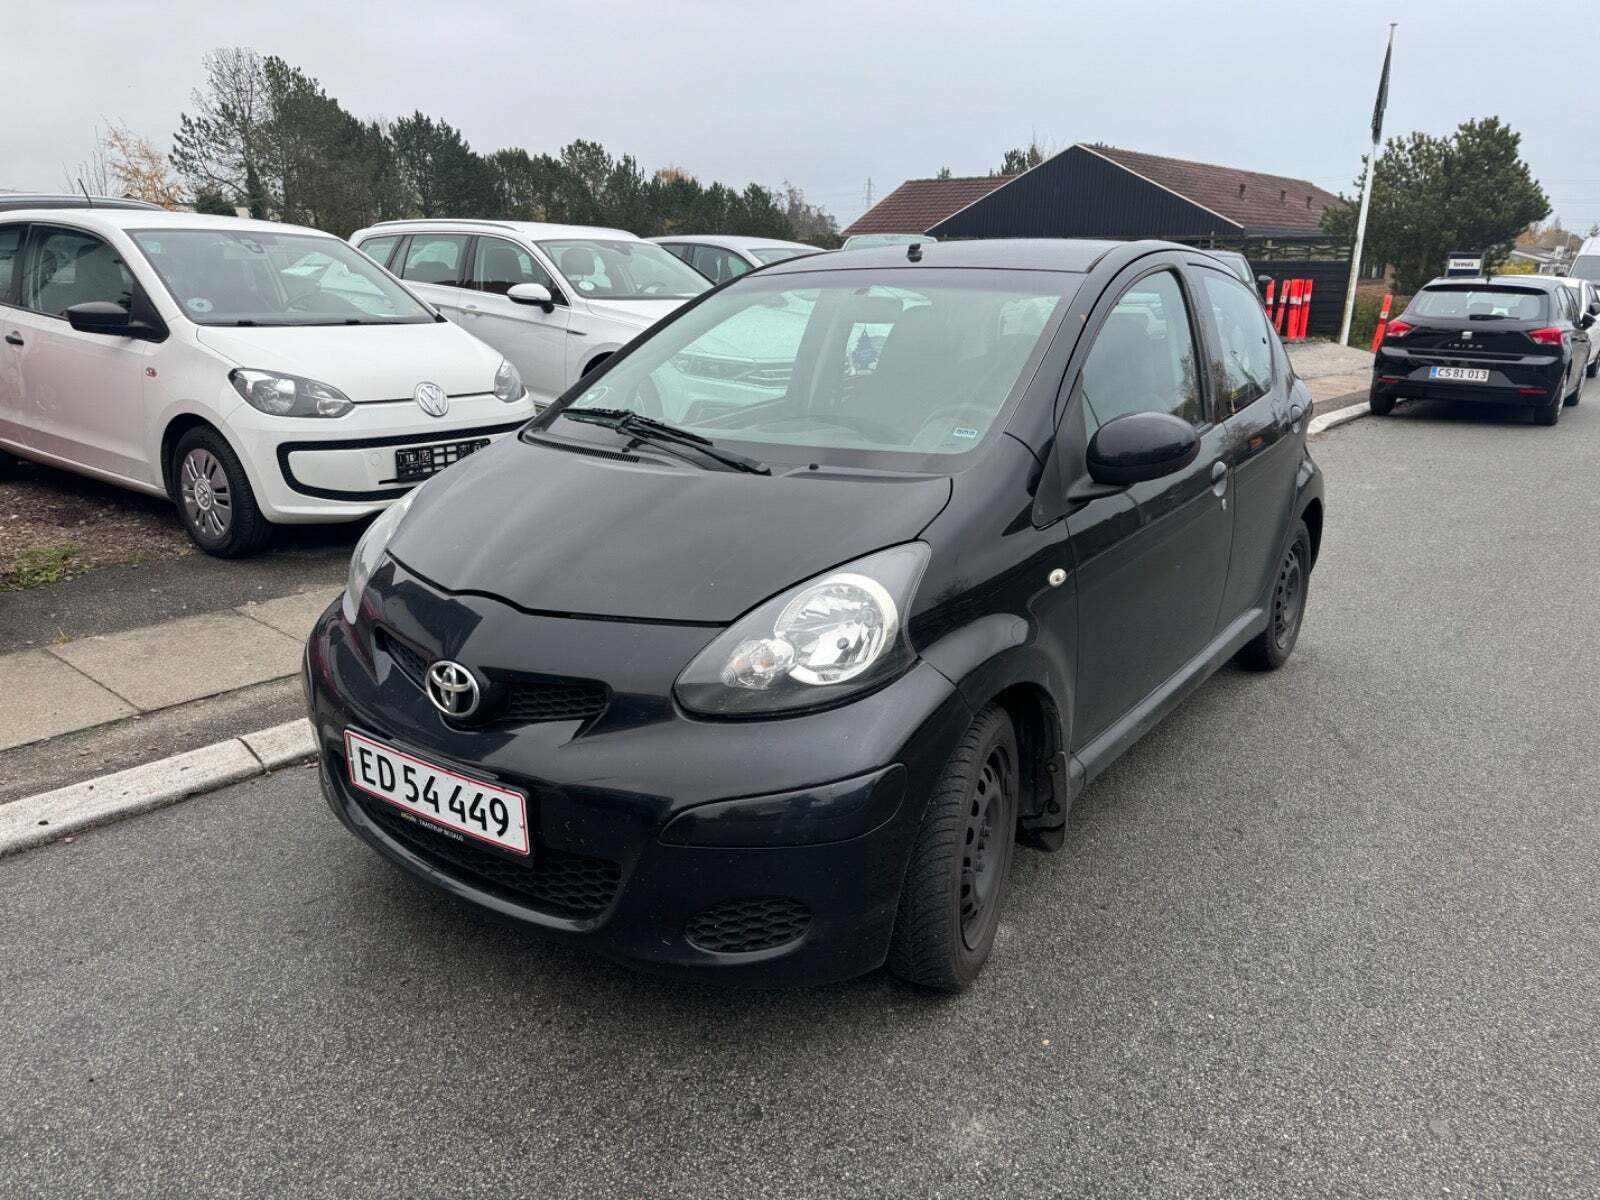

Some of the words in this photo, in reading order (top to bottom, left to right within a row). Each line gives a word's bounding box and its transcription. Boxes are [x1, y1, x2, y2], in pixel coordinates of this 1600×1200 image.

[1438, 368, 1451, 377] CS
[1453, 369, 1464, 378] 81
[1468, 370, 1488, 380] 013
[359, 747, 396, 792] ED
[403, 764, 440, 813] 54
[449, 785, 509, 837] 449
